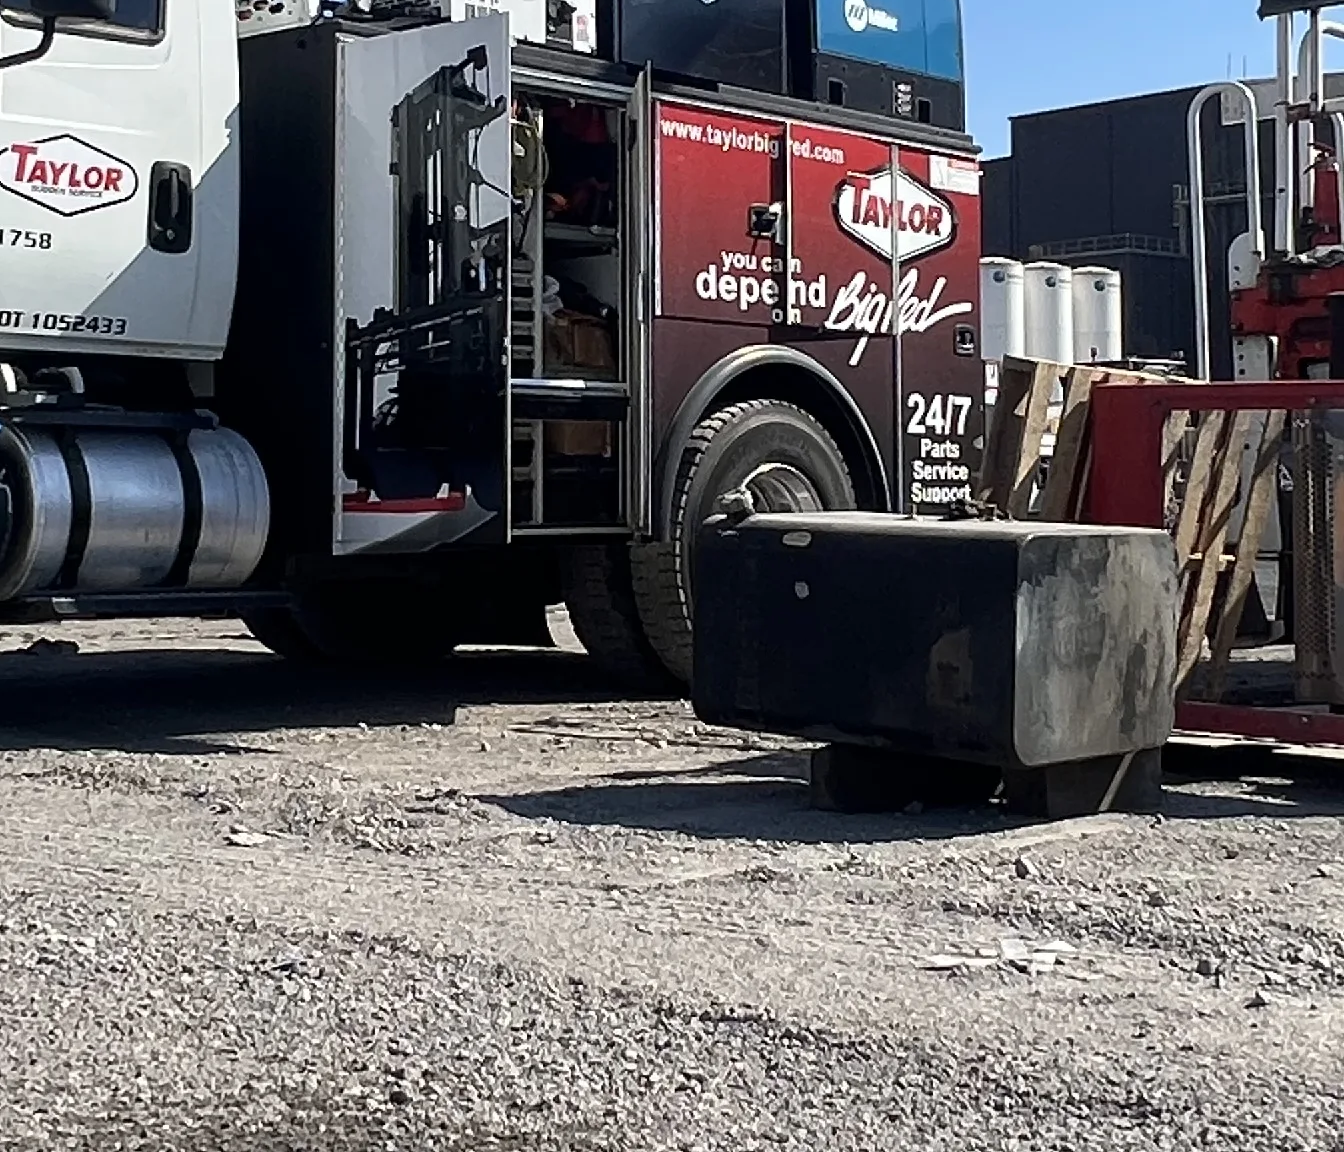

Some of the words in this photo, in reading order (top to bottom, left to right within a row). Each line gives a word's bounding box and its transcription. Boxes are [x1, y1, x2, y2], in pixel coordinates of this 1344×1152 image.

[10, 143, 123, 193] TAYLOR
[847, 176, 943, 237] TAYLOR
[721, 250, 757, 272] you
[761, 256, 802, 274] can
[695, 264, 827, 311] depend
[31, 311, 128, 335] 1052433
[771, 308, 802, 325] on
[906, 392, 972, 436] 24/7
[920, 438, 960, 459] Parts
[912, 460, 970, 481] Service
[911, 482, 972, 504] Support
